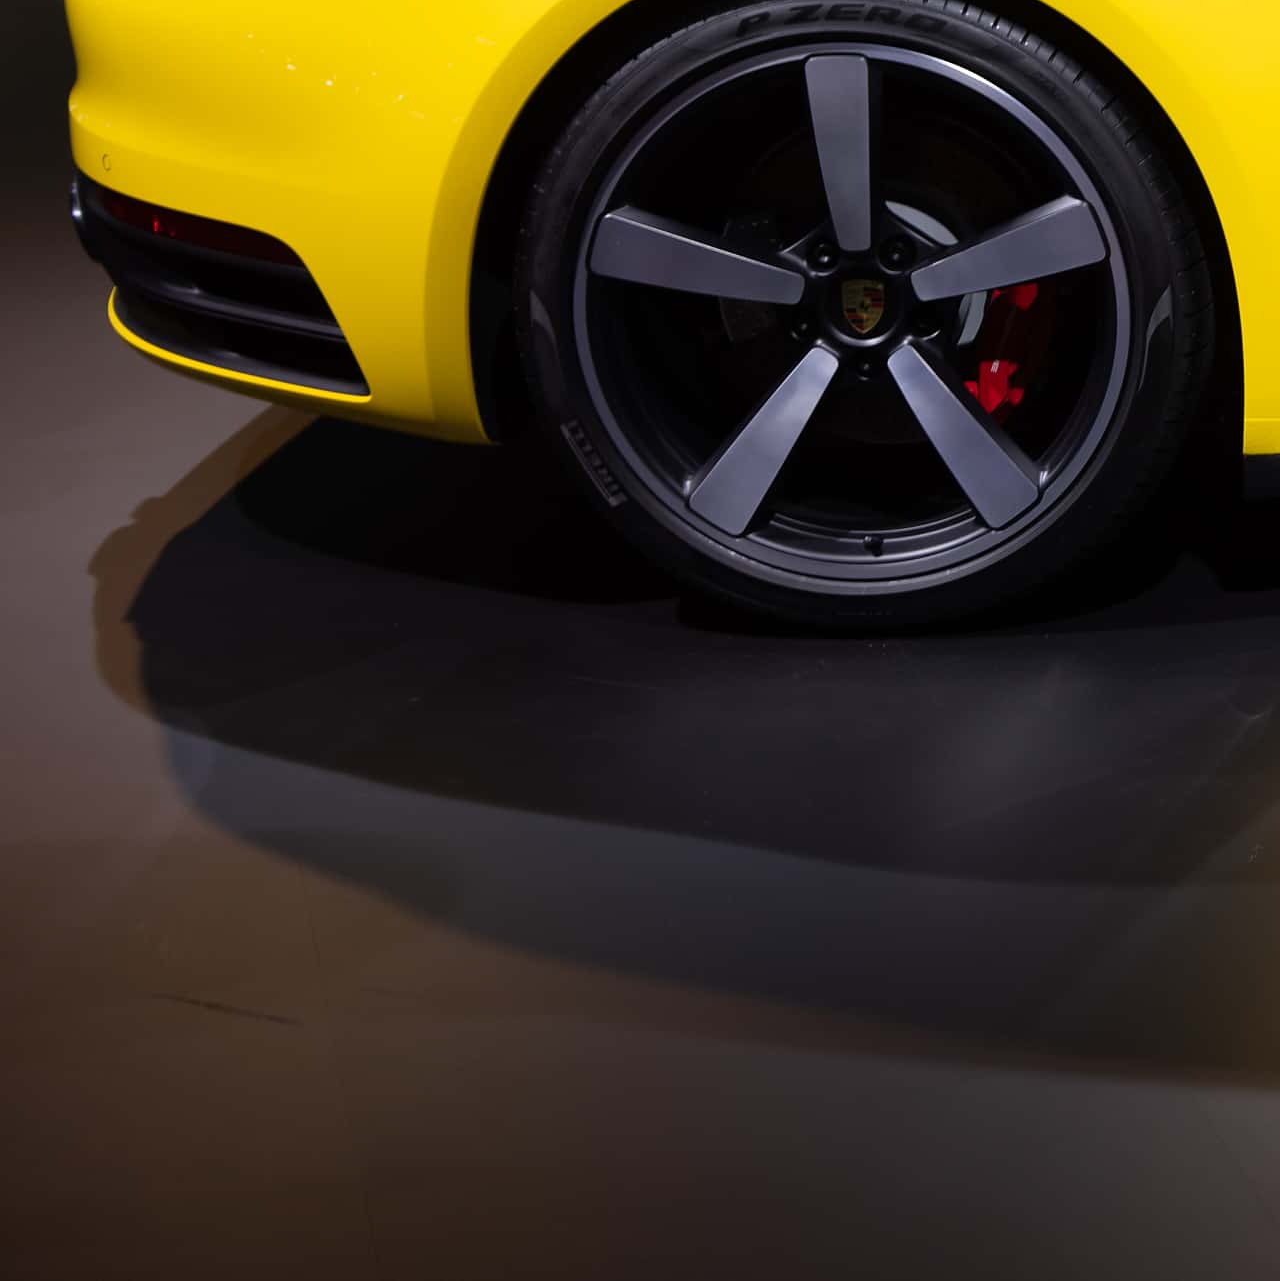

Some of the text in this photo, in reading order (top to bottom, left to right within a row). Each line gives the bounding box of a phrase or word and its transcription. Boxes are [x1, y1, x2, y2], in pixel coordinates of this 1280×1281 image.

[736, 3, 947, 37] P ZERO
[560, 419, 628, 507] PIRELLI
